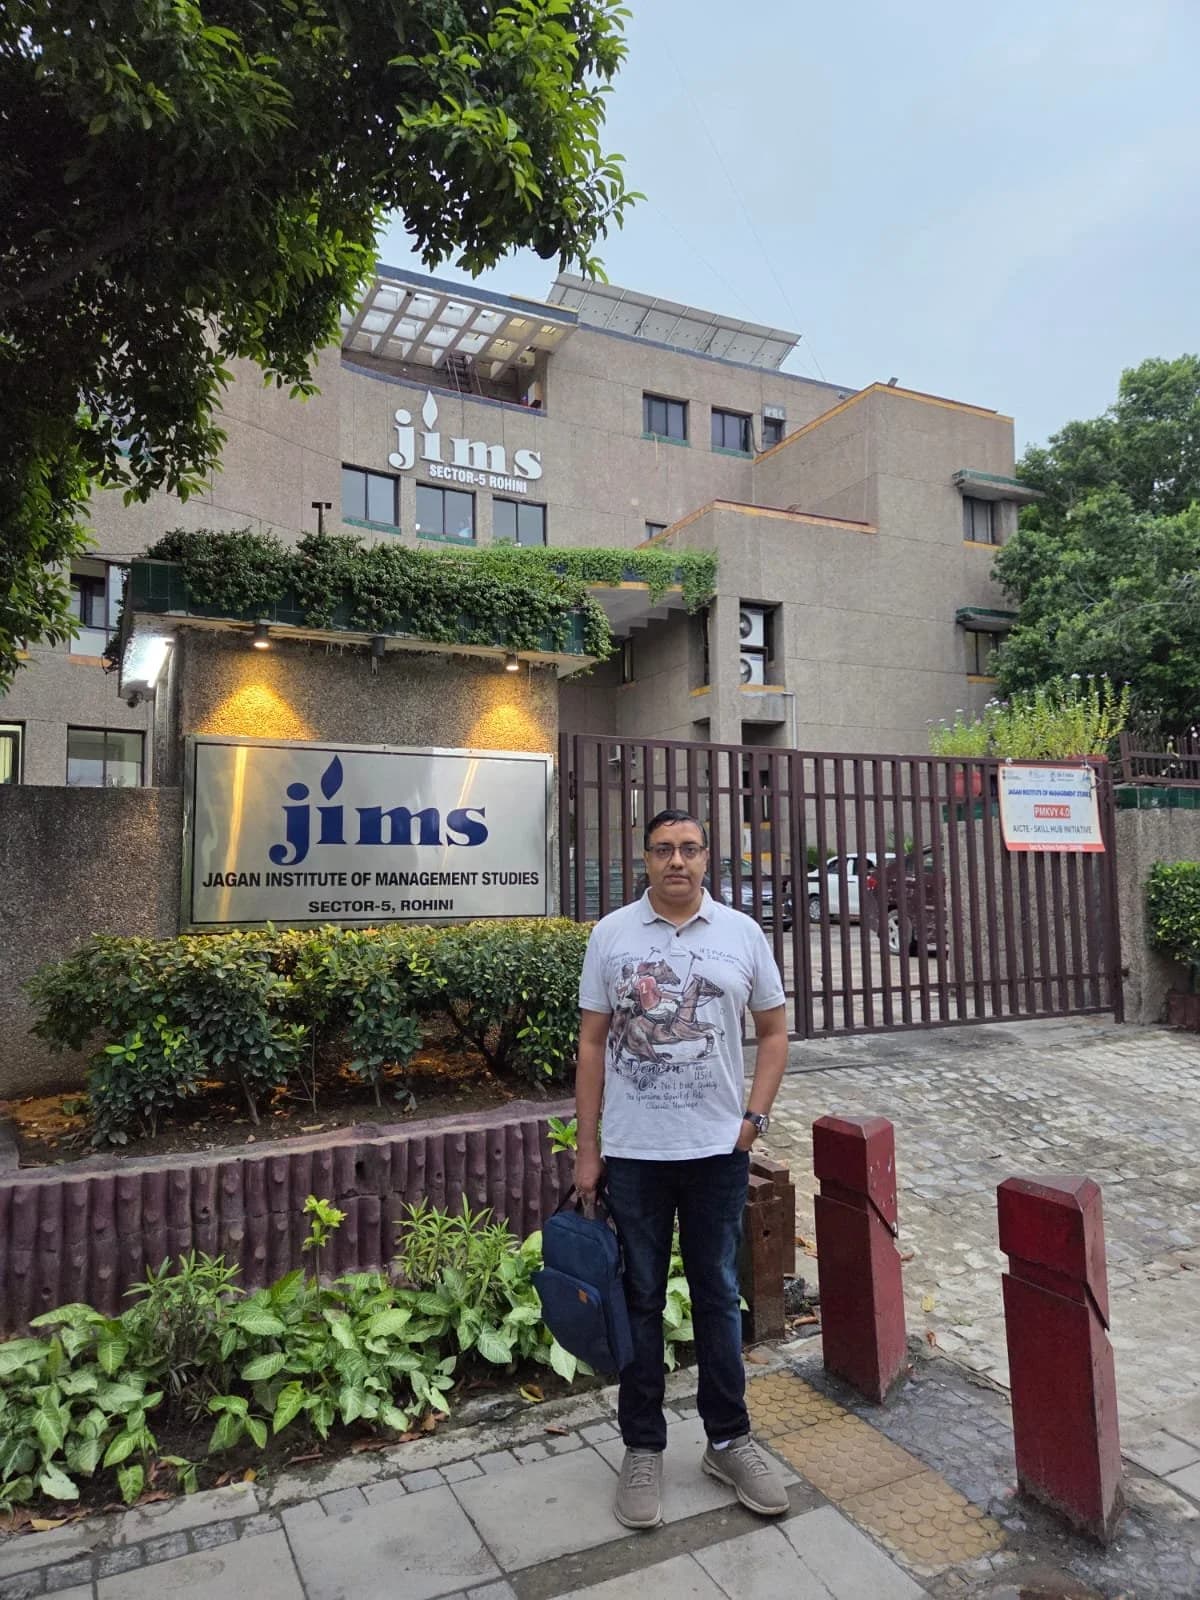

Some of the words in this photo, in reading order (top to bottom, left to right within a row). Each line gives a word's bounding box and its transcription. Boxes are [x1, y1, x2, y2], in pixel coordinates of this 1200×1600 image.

[388, 390, 543, 480] jims
[429, 464, 486, 487] SECTOR-5
[489, 476, 528, 494] ROHINI
[268, 754, 489, 866] jims
[1035, 806, 1058, 817] PMKVY
[202, 871, 261, 888] JAGAN
[265, 871, 348, 888] INSTITUTE
[351, 871, 372, 886] OF
[375, 871, 479, 887] MANAGEMENT
[482, 871, 540, 886] STUDIES
[308, 900, 396, 914] SECTOR-5,
[400, 898, 454, 912] ROHINI
